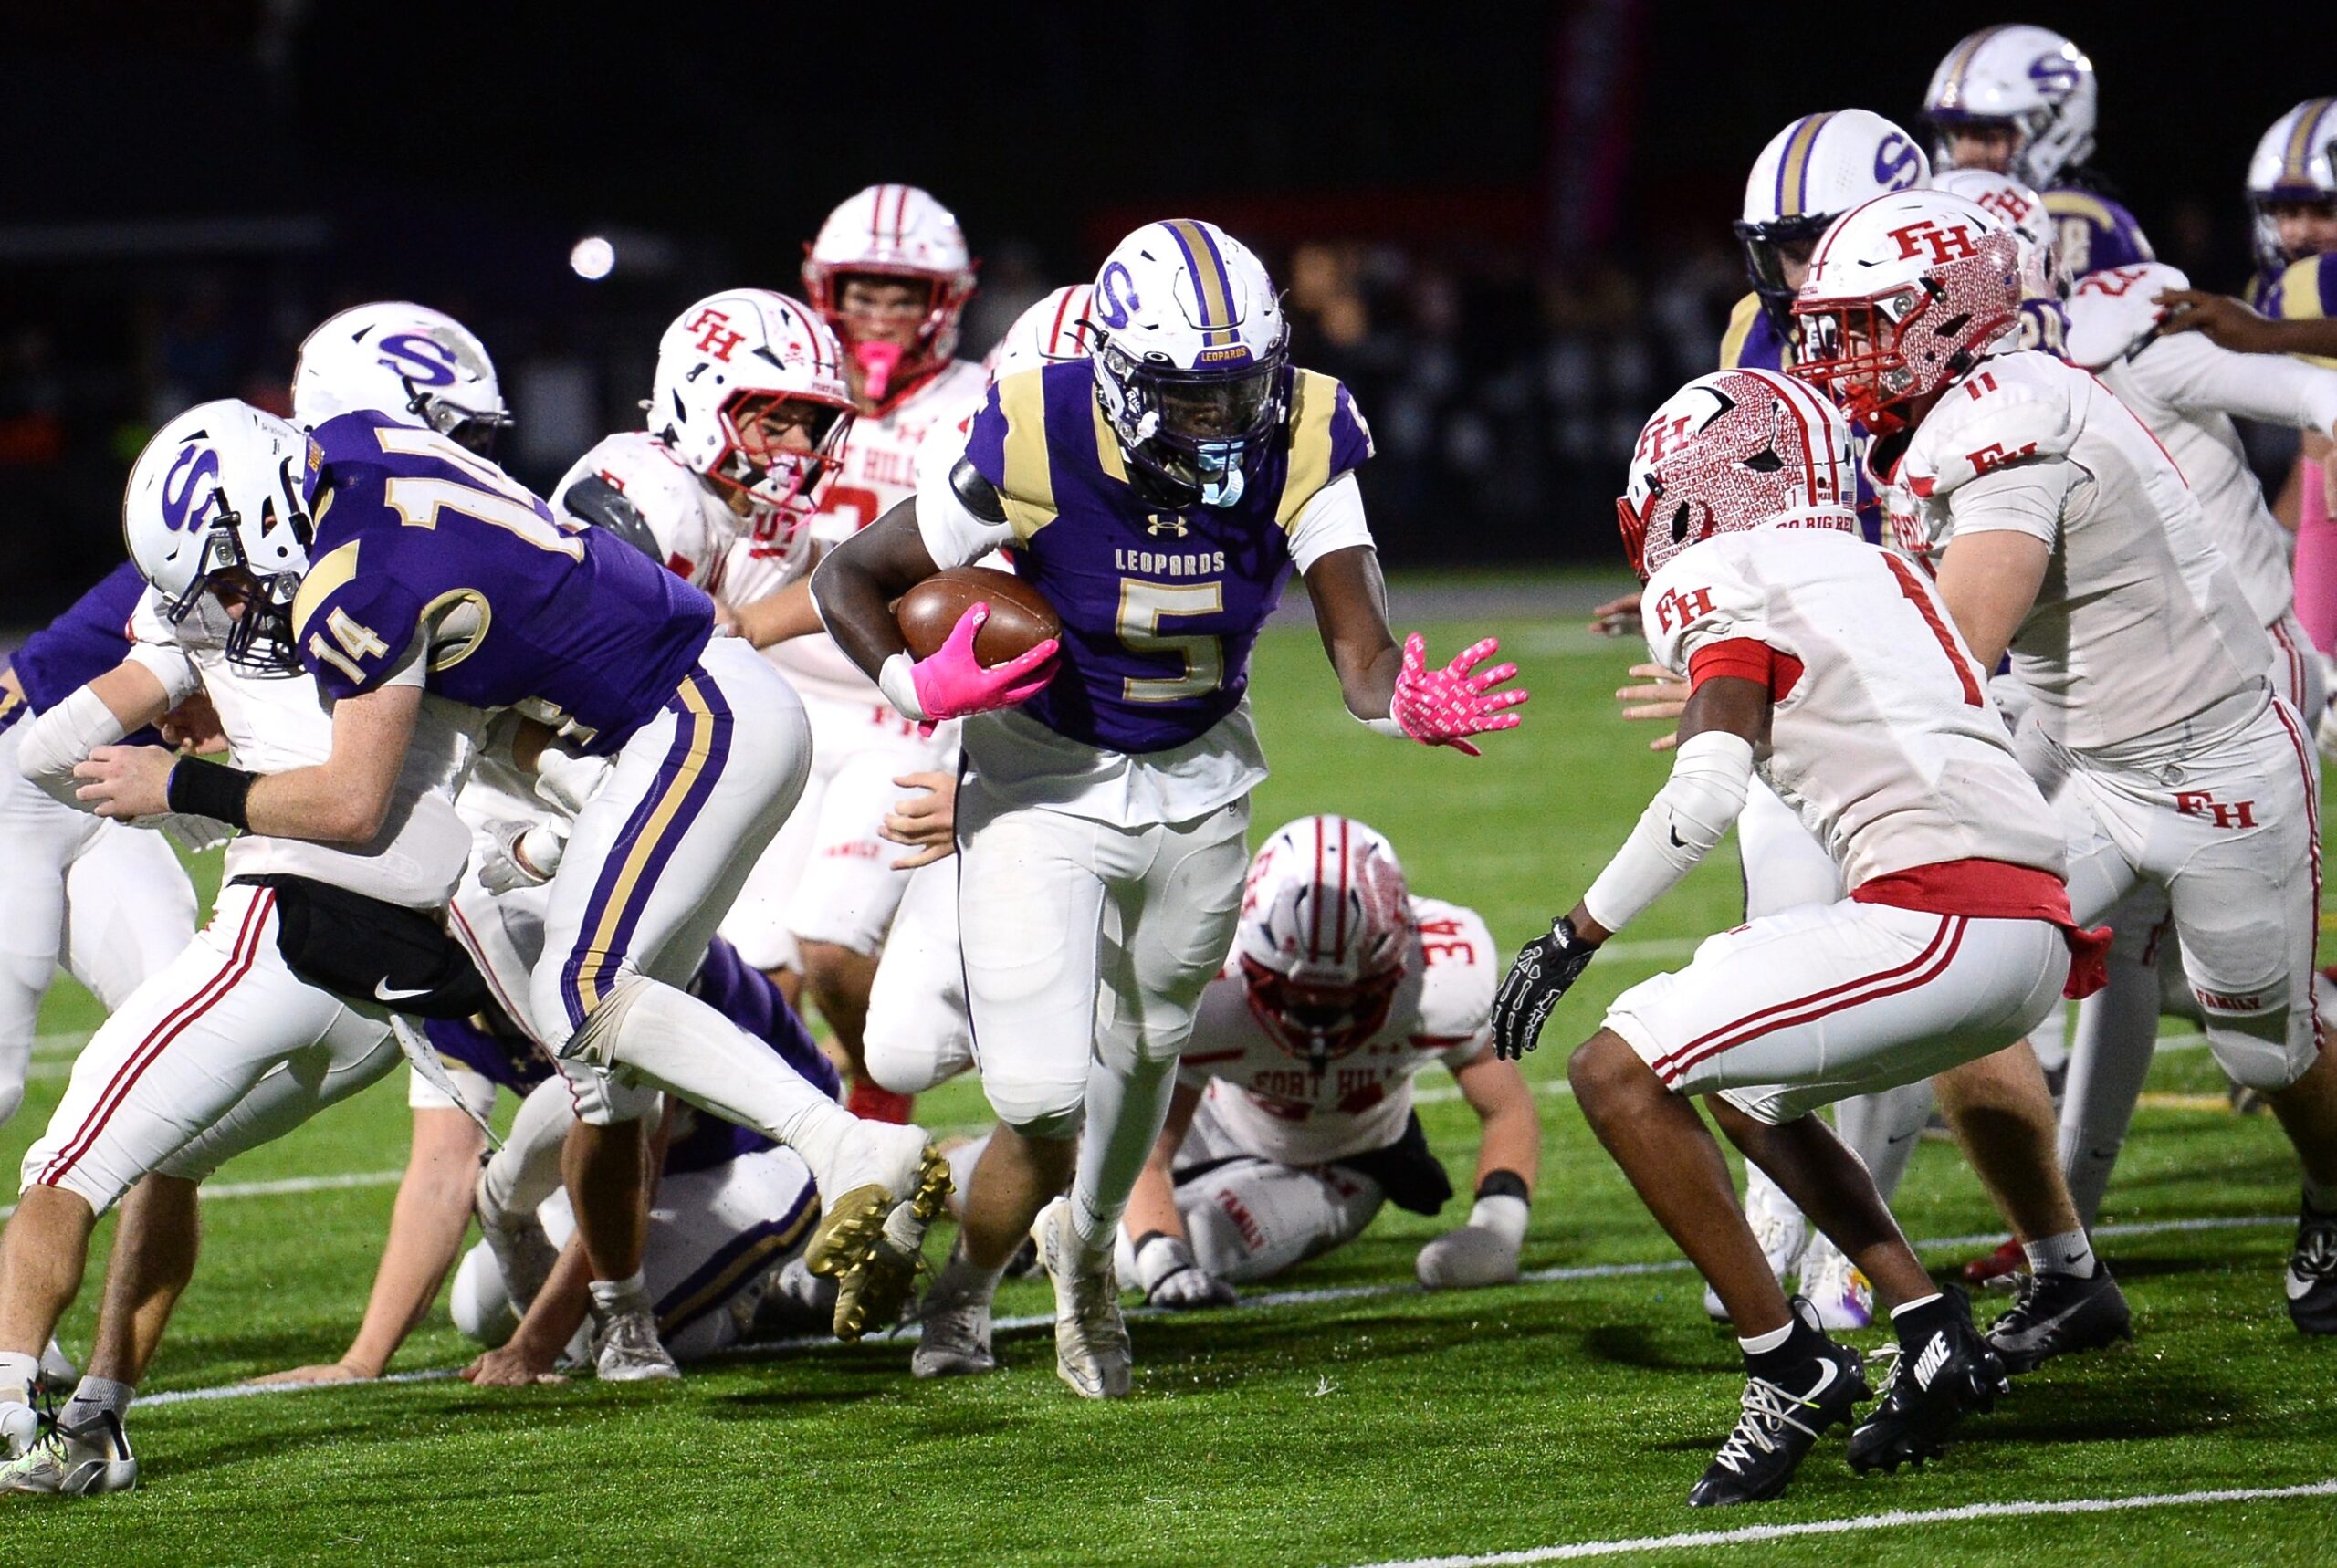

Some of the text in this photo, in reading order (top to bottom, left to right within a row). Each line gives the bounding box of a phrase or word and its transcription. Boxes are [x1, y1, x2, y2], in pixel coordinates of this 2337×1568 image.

[1874, 131, 1921, 192] S
[1887, 220, 1980, 266] FH
[1095, 260, 1141, 330] S
[377, 334, 459, 387] S
[685, 308, 746, 363] FH
[1200, 346, 1248, 363] LEOPARDS
[1964, 371, 1997, 401] 11
[1635, 413, 1692, 465] FH
[162, 443, 220, 536] S
[1790, 488, 1797, 507] 1
[1806, 516, 1833, 529] BIG
[1115, 549, 1225, 576] LEOPARDS
[1655, 586, 1718, 635] FH
[1878, 551, 1984, 709] 1
[308, 605, 390, 685] 14
[1115, 576, 1225, 704] 5
[2176, 790, 2258, 829] FH
[1416, 918, 1476, 967] 34
[2196, 988, 2261, 1011] FAMILY
[1216, 1188, 1266, 1252] FAMILY
[1913, 1330, 1951, 1393] NIKE
